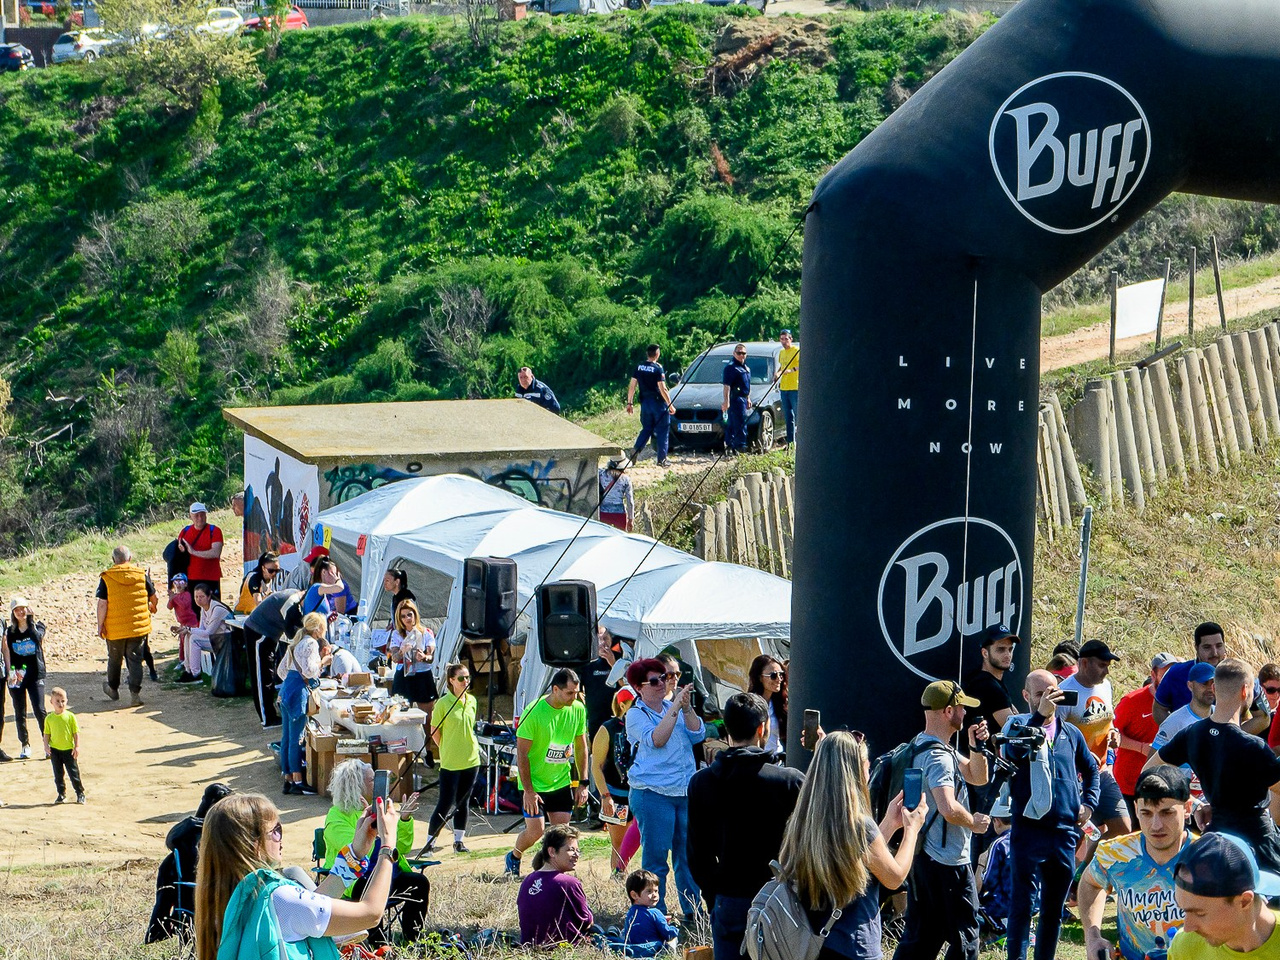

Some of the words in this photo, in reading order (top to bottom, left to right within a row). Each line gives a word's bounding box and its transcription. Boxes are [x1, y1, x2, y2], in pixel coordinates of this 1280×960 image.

[899, 355, 1026, 370] LIVE
[897, 398, 1024, 411] MORE
[929, 441, 1002, 454] NOW
